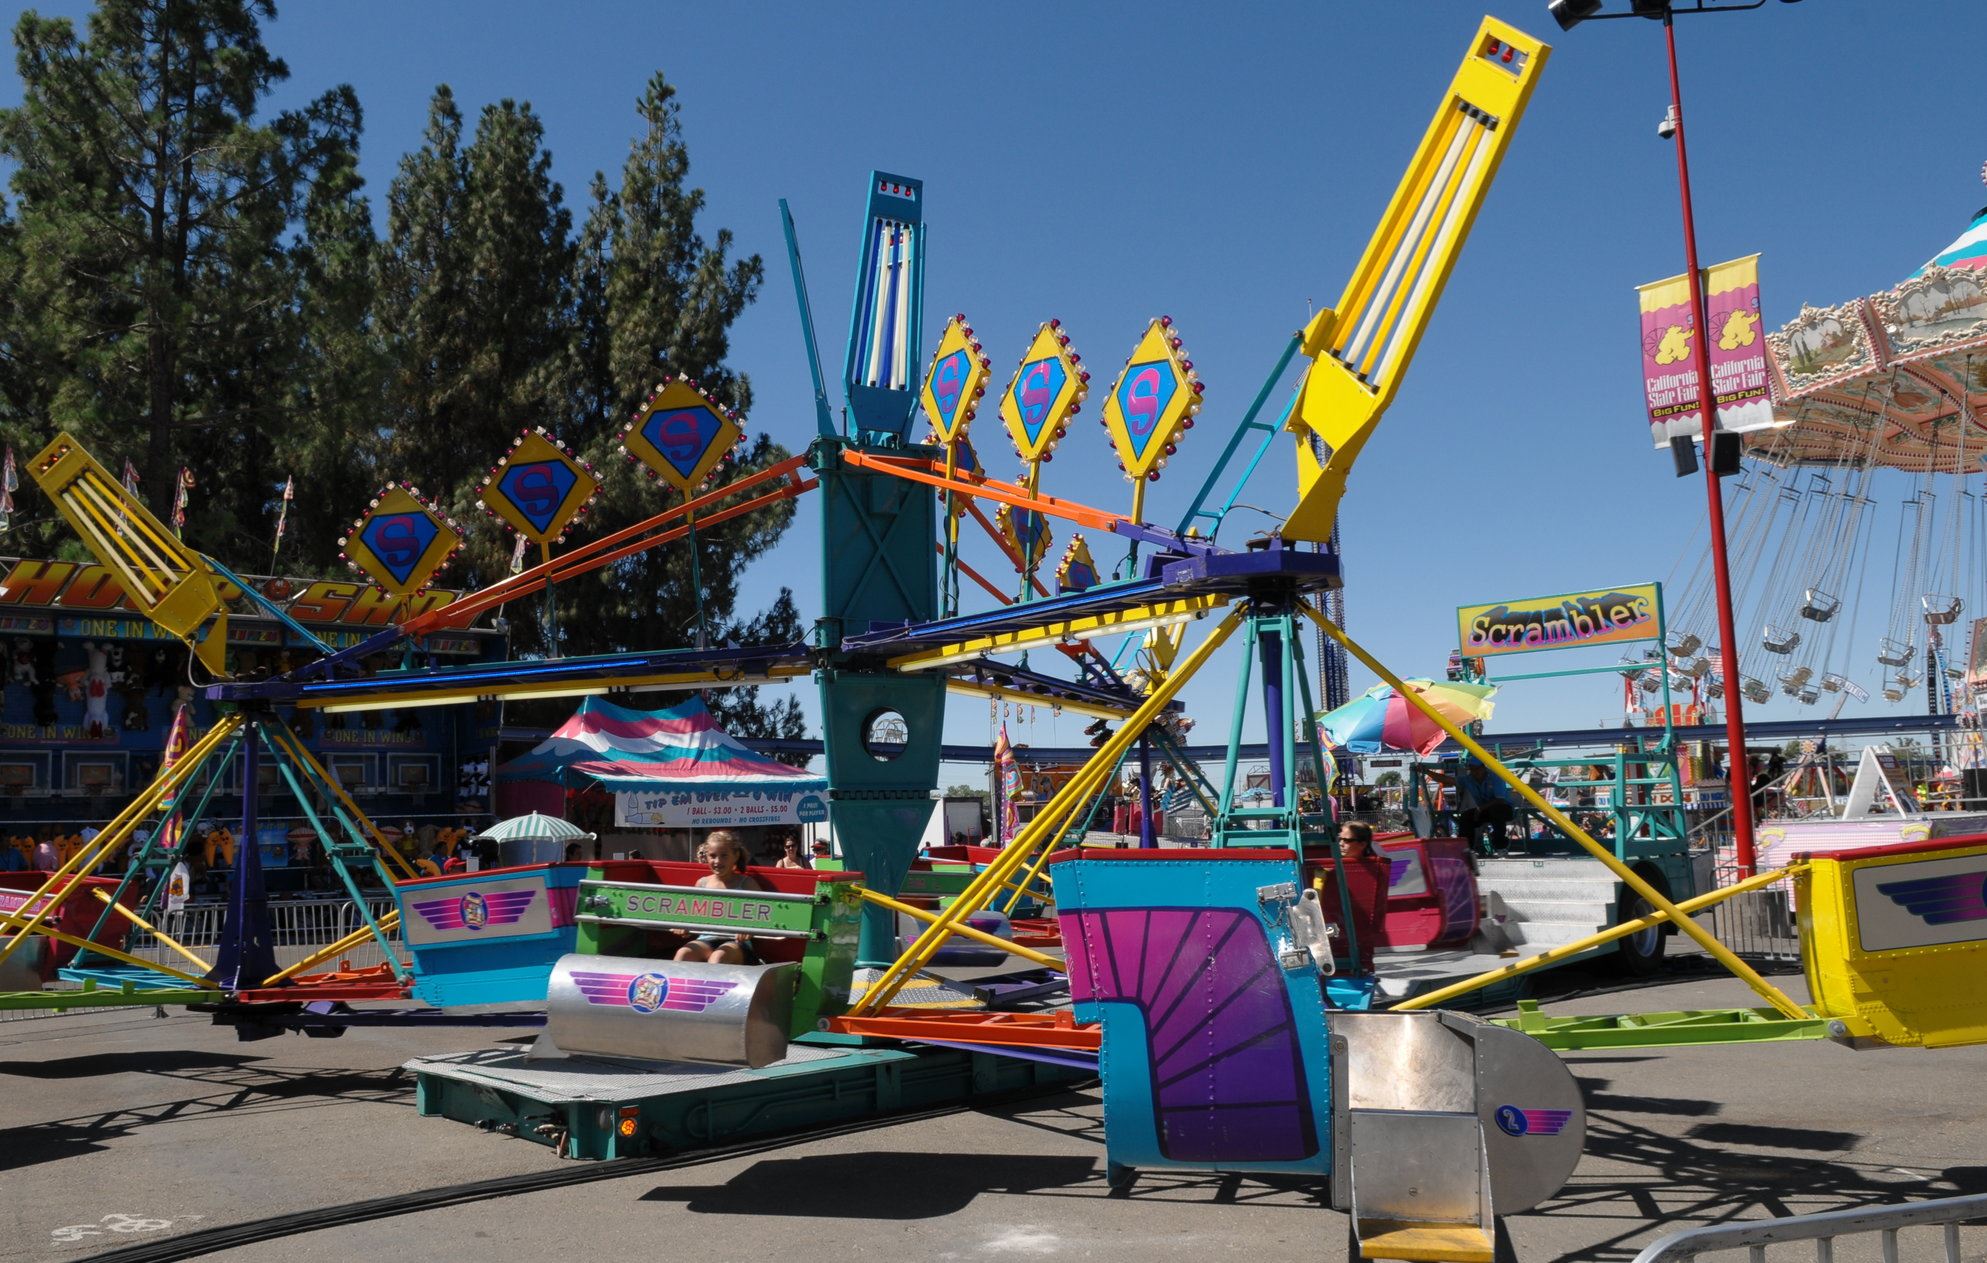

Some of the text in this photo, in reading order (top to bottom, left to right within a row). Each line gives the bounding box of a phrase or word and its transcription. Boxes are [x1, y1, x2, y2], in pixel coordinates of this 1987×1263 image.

[1710, 355, 1765, 380] California
[1646, 369, 1699, 393] California
[1712, 370, 1766, 395] State Fair
[1648, 385, 1700, 408] State Fair
[1717, 394, 1736, 404] BIG
[1653, 408, 1672, 417] BIG
[80, 620, 118, 637] ONE
[125, 620, 144, 637] IN
[1468, 596, 1651, 648] Scrambler
[8, 724, 36, 739] ONE
[334, 730, 359, 743] ONE
[363, 730, 376, 743] IN
[644, 798, 668, 810] TIP
[691, 807, 707, 815] BALL
[713, 806, 732, 814] $3.00
[745, 805, 764, 814] BALLS
[770, 805, 788, 813] $5.00
[691, 817, 700, 825] NO
[626, 895, 773, 921] SCRAMBLER
[1502, 1108, 1520, 1131] 2
